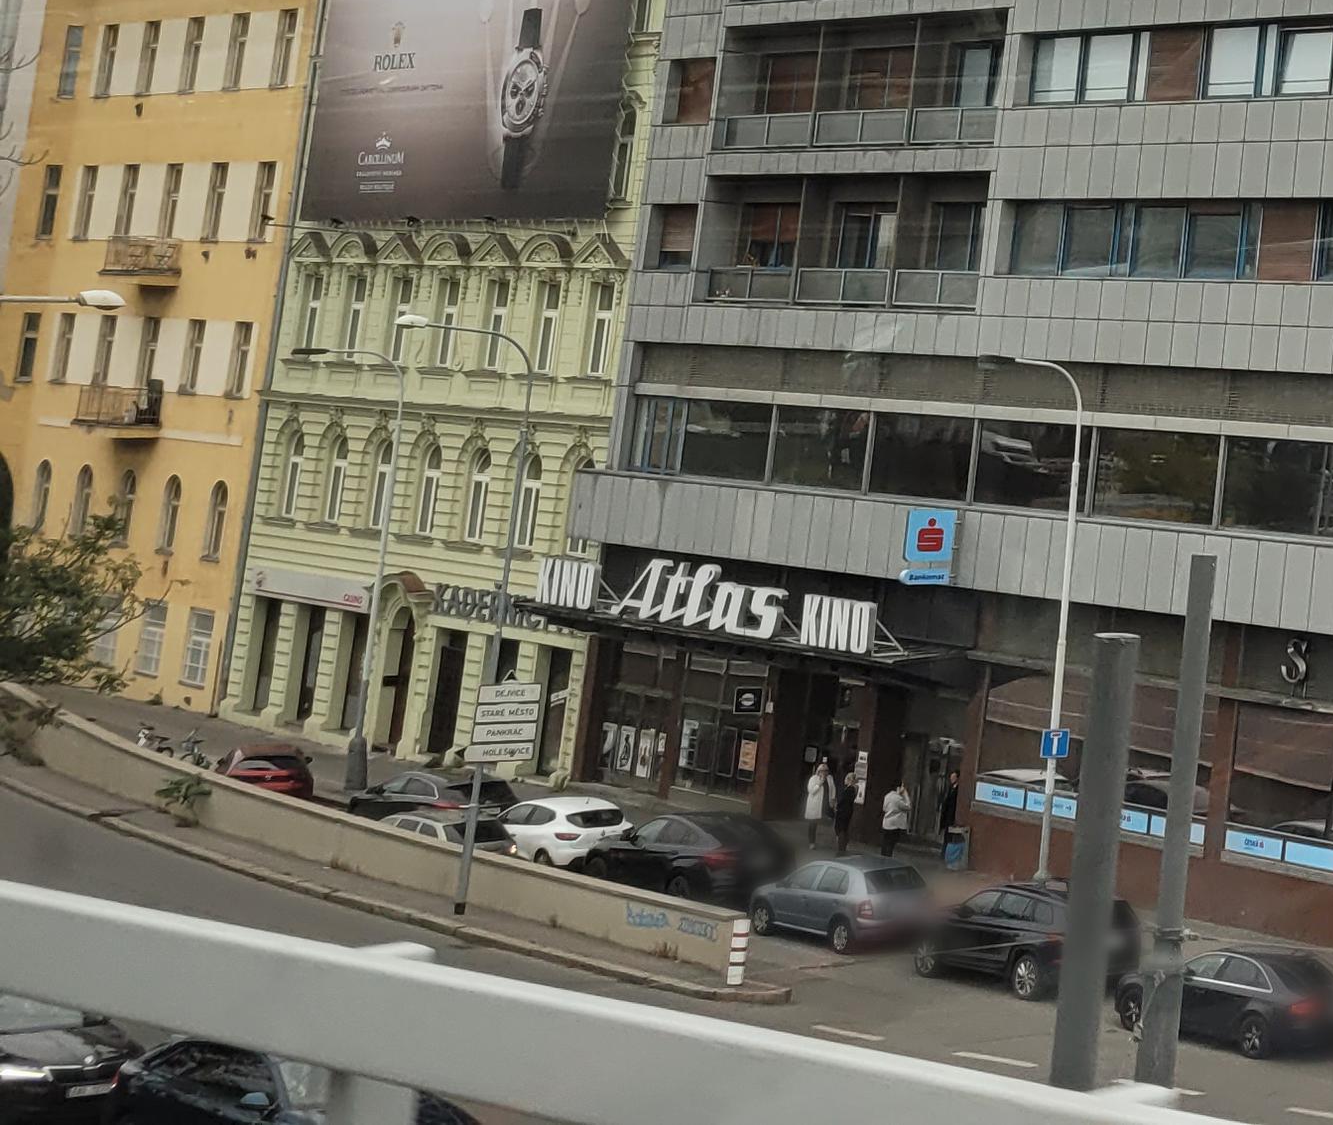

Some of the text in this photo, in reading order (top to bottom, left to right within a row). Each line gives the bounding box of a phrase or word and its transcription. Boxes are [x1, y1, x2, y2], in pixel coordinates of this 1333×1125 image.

[373, 52, 416, 72] ROLEX
[535, 558, 600, 611] KINO
[610, 559, 790, 639] Atlas
[800, 594, 877, 654] KINO
